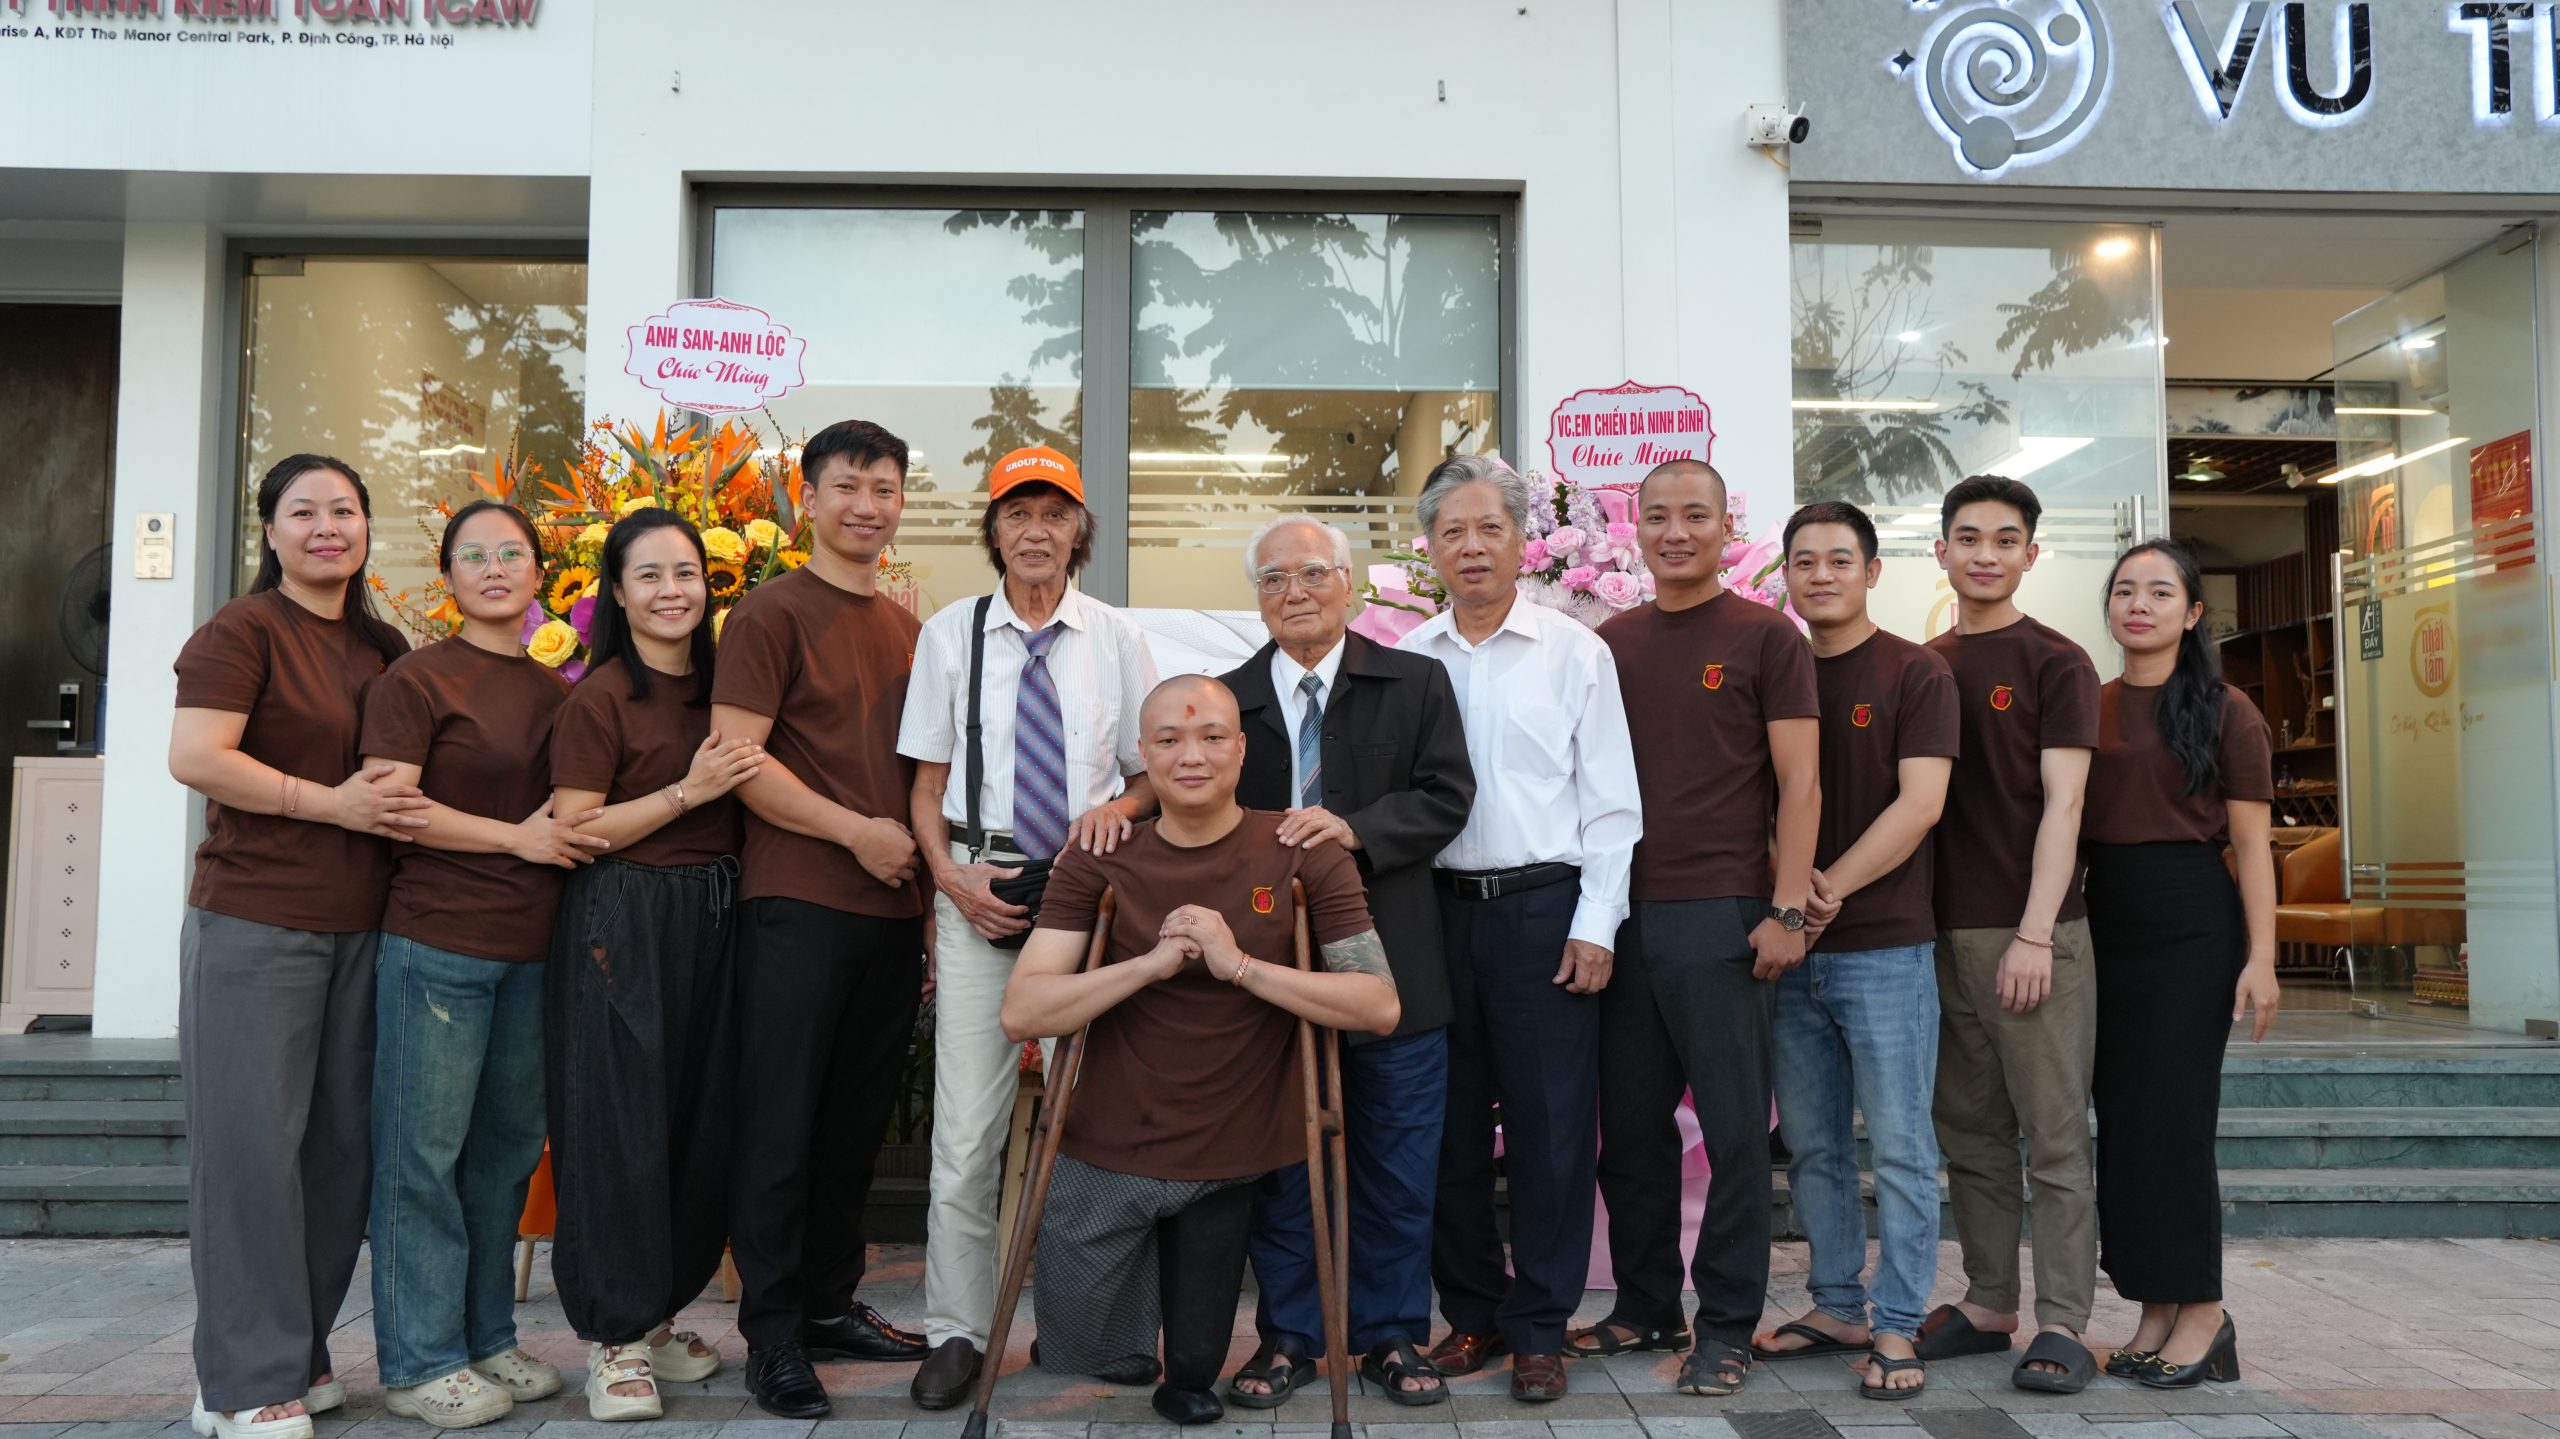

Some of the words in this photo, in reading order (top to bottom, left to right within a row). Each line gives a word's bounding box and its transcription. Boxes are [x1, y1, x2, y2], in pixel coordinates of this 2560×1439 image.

[0, 25, 28, 38] rise
[34, 26, 49, 40] A,
[55, 27, 84, 39] KĐT
[91, 28, 117, 40] The
[124, 28, 171, 42] Manor
[177, 31, 231, 42] Central
[237, 32, 275, 45] Park,
[282, 32, 293, 44] P.
[299, 33, 331, 47] Định
[336, 32, 378, 48] Công,
[382, 34, 400, 45] TP.
[431, 34, 454, 49] Nội
[2460, 2, 2560, 115] T
[645, 325, 678, 348] ANH
[682, 328, 752, 354] SAN-ANH
[756, 330, 786, 361] LỘC
[657, 357, 702, 379] Chúc
[1557, 414, 1592, 438] VC.EM
[1594, 405, 1627, 437] CHIẾN
[1630, 407, 1645, 435] ĐÁ
[1648, 411, 1675, 434] NINH
[1677, 405, 1704, 433] BÌNH
[1006, 458, 1038, 472] GROUP
[1039, 459, 1065, 472] TOUR
[1572, 443, 1624, 468] Chúc
